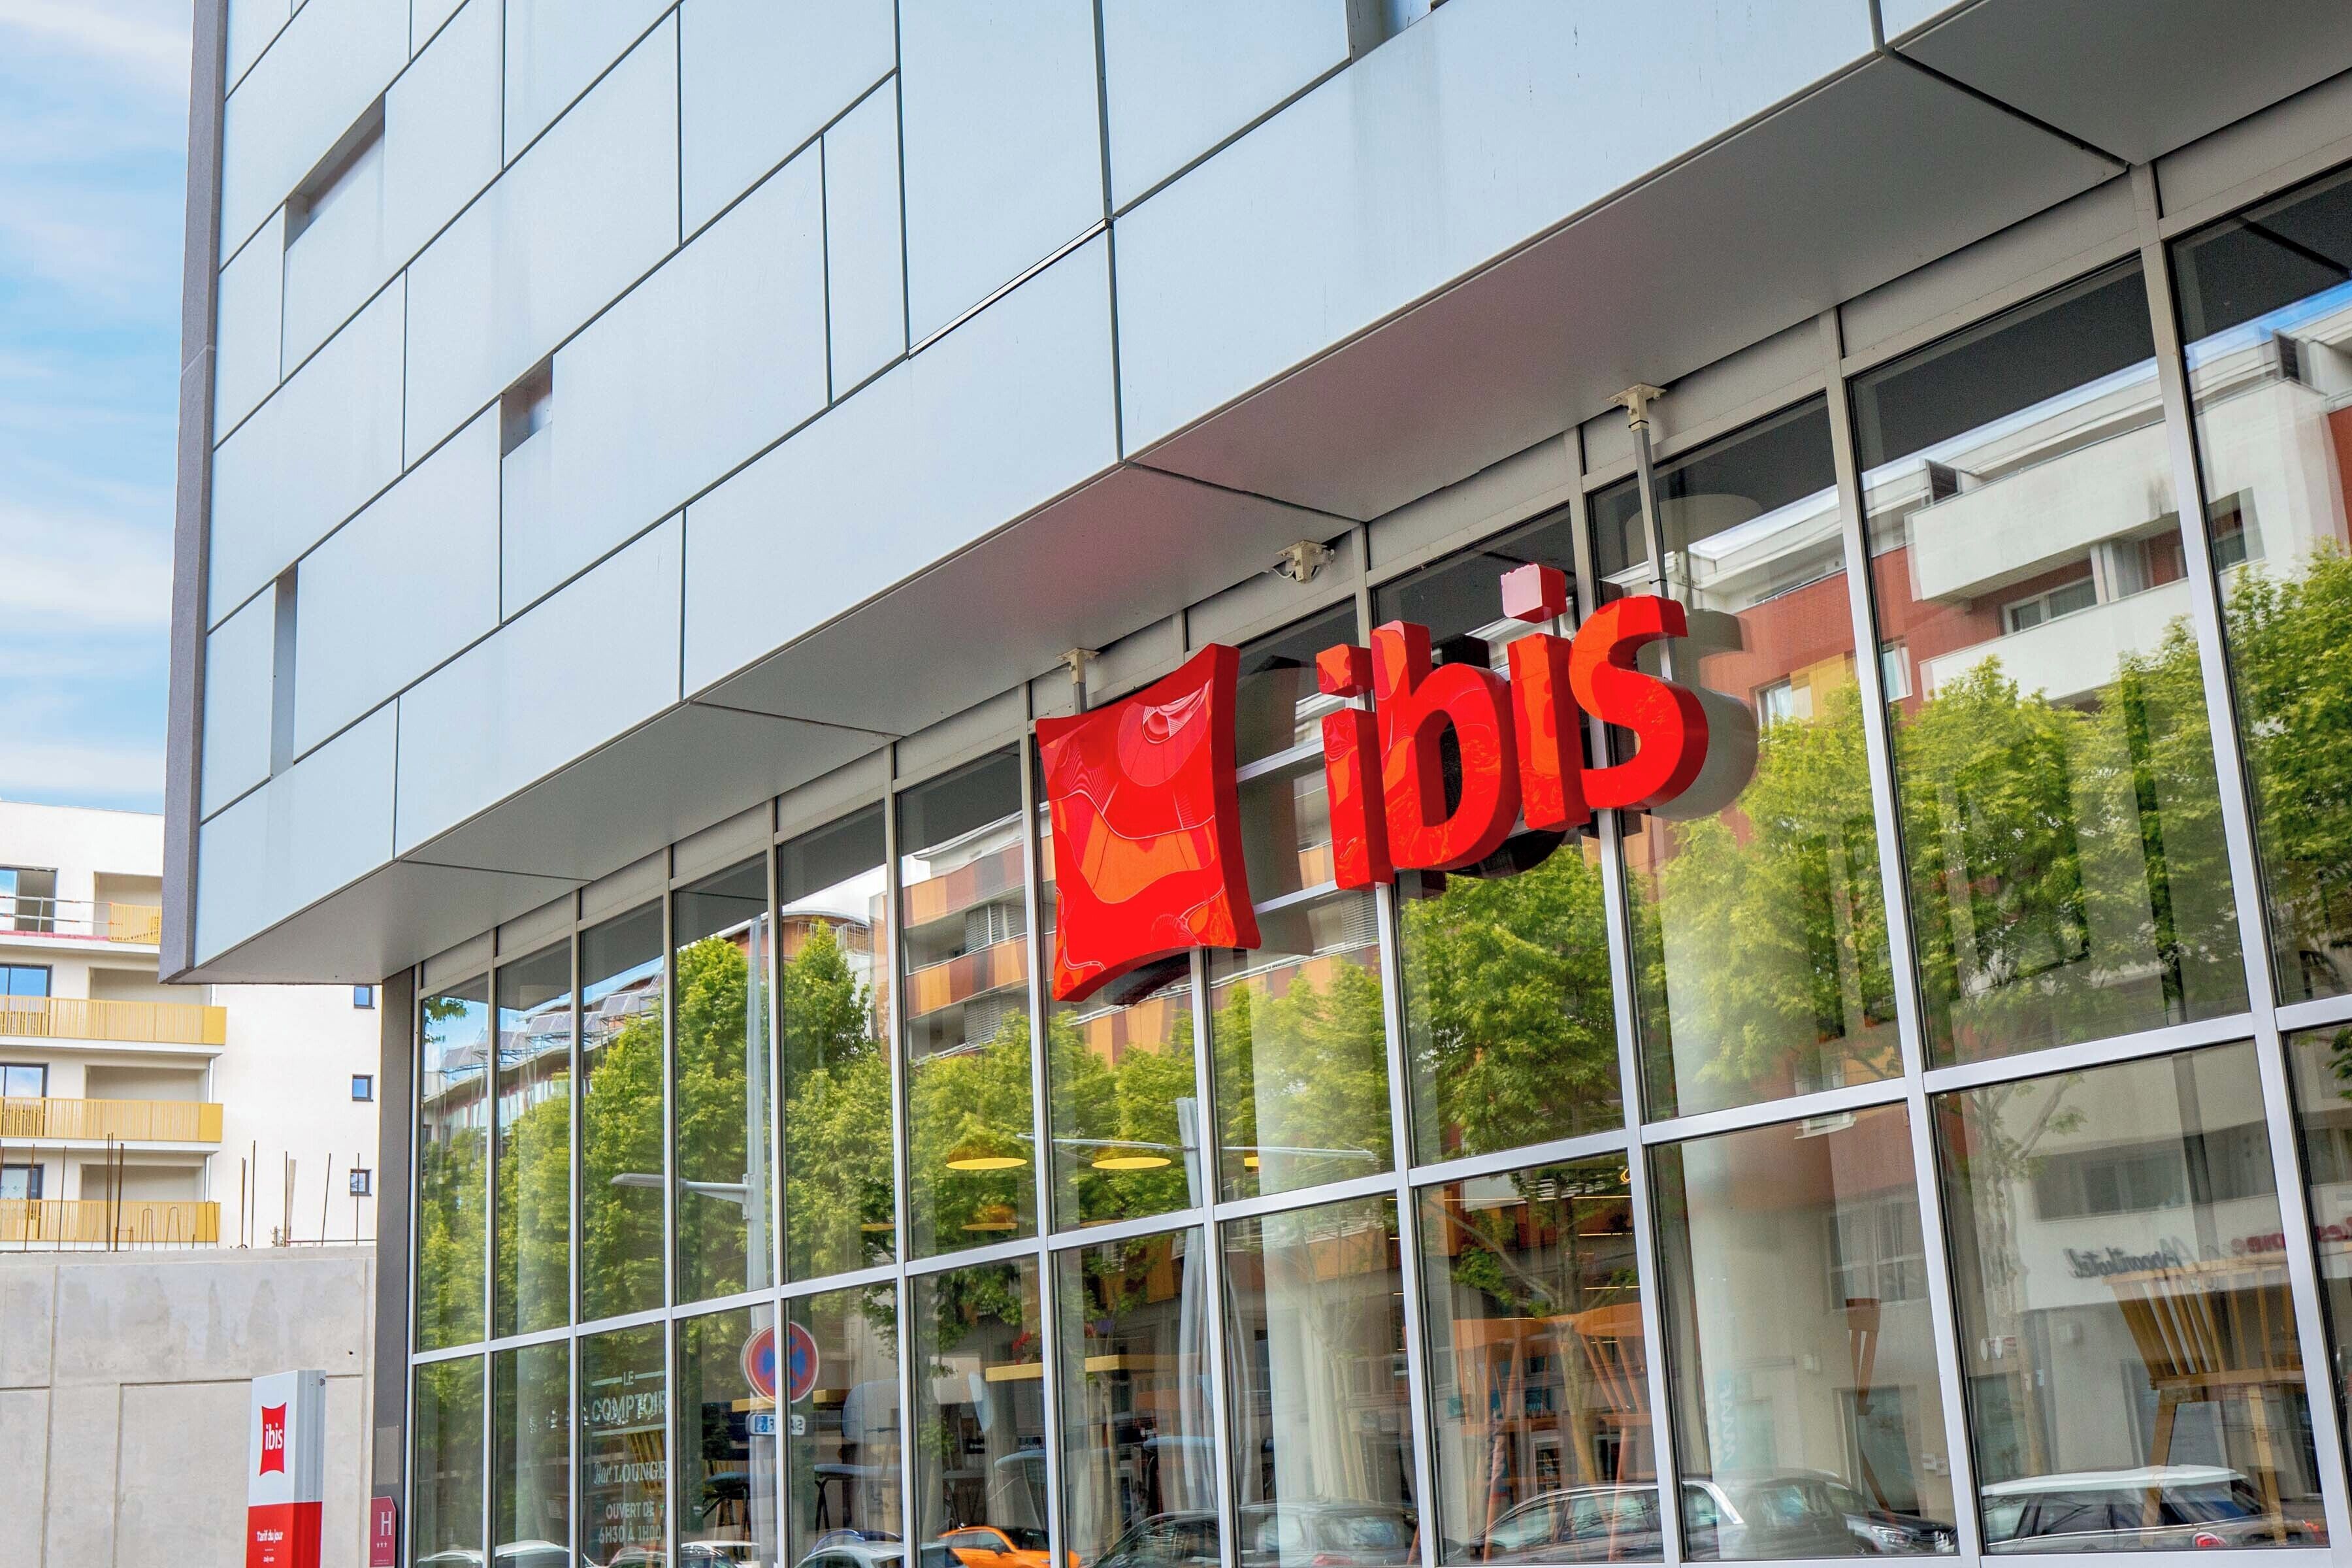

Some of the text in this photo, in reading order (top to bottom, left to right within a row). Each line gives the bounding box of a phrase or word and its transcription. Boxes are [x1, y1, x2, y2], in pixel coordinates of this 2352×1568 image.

[1316, 563, 1709, 891] ibis
[623, 1370, 634, 1386] LE
[265, 1422, 283, 1450] ibis
[593, 1460, 666, 1485] Bar LOUNGE
[606, 1501, 655, 1519] OUVERT DE
[380, 1511, 392, 1537] H
[599, 1525, 625, 1544] 6H30
